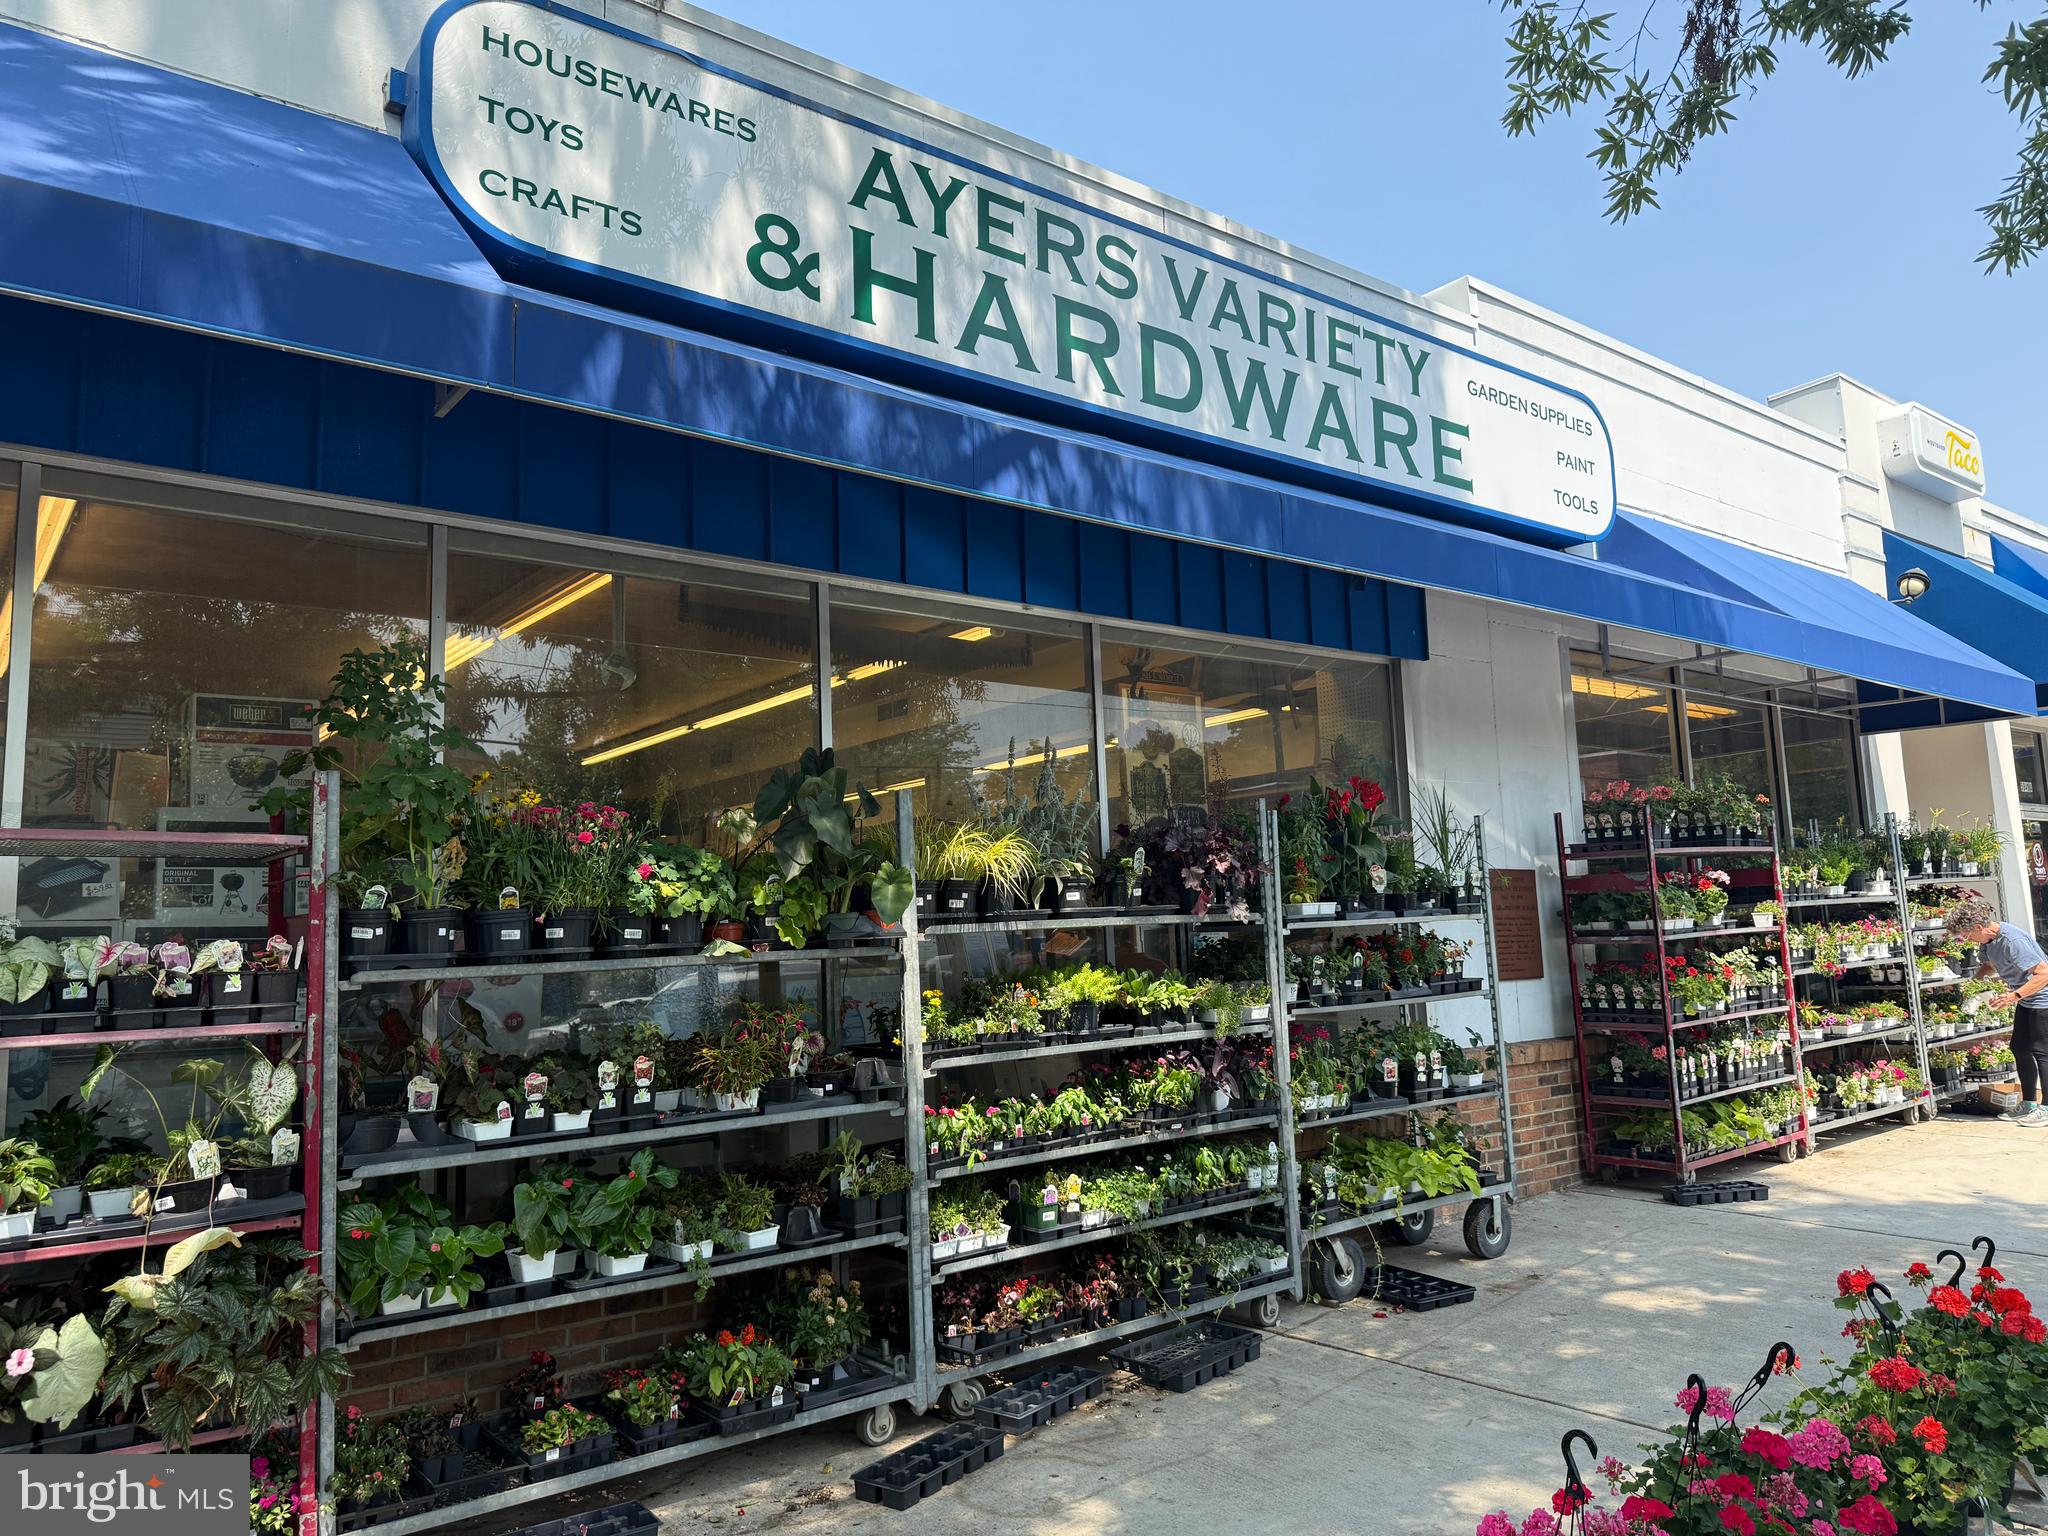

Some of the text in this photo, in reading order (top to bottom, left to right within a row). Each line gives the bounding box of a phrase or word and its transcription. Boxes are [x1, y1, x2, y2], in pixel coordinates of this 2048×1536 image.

[482, 25, 757, 143] HOUSEWARES
[479, 95, 584, 151] TOYS
[478, 168, 643, 237] CRAFTS
[848, 146, 1431, 398] AYERS VARIETY
[746, 213, 1474, 495] & HARDWARE
[1467, 380, 1593, 437] GARDEN SUPPLIES
[1557, 451, 1595, 476] PAINT
[1945, 430, 1979, 475] Taco
[1553, 489, 1599, 515] TOOLS
[233, 705, 266, 721] weber
